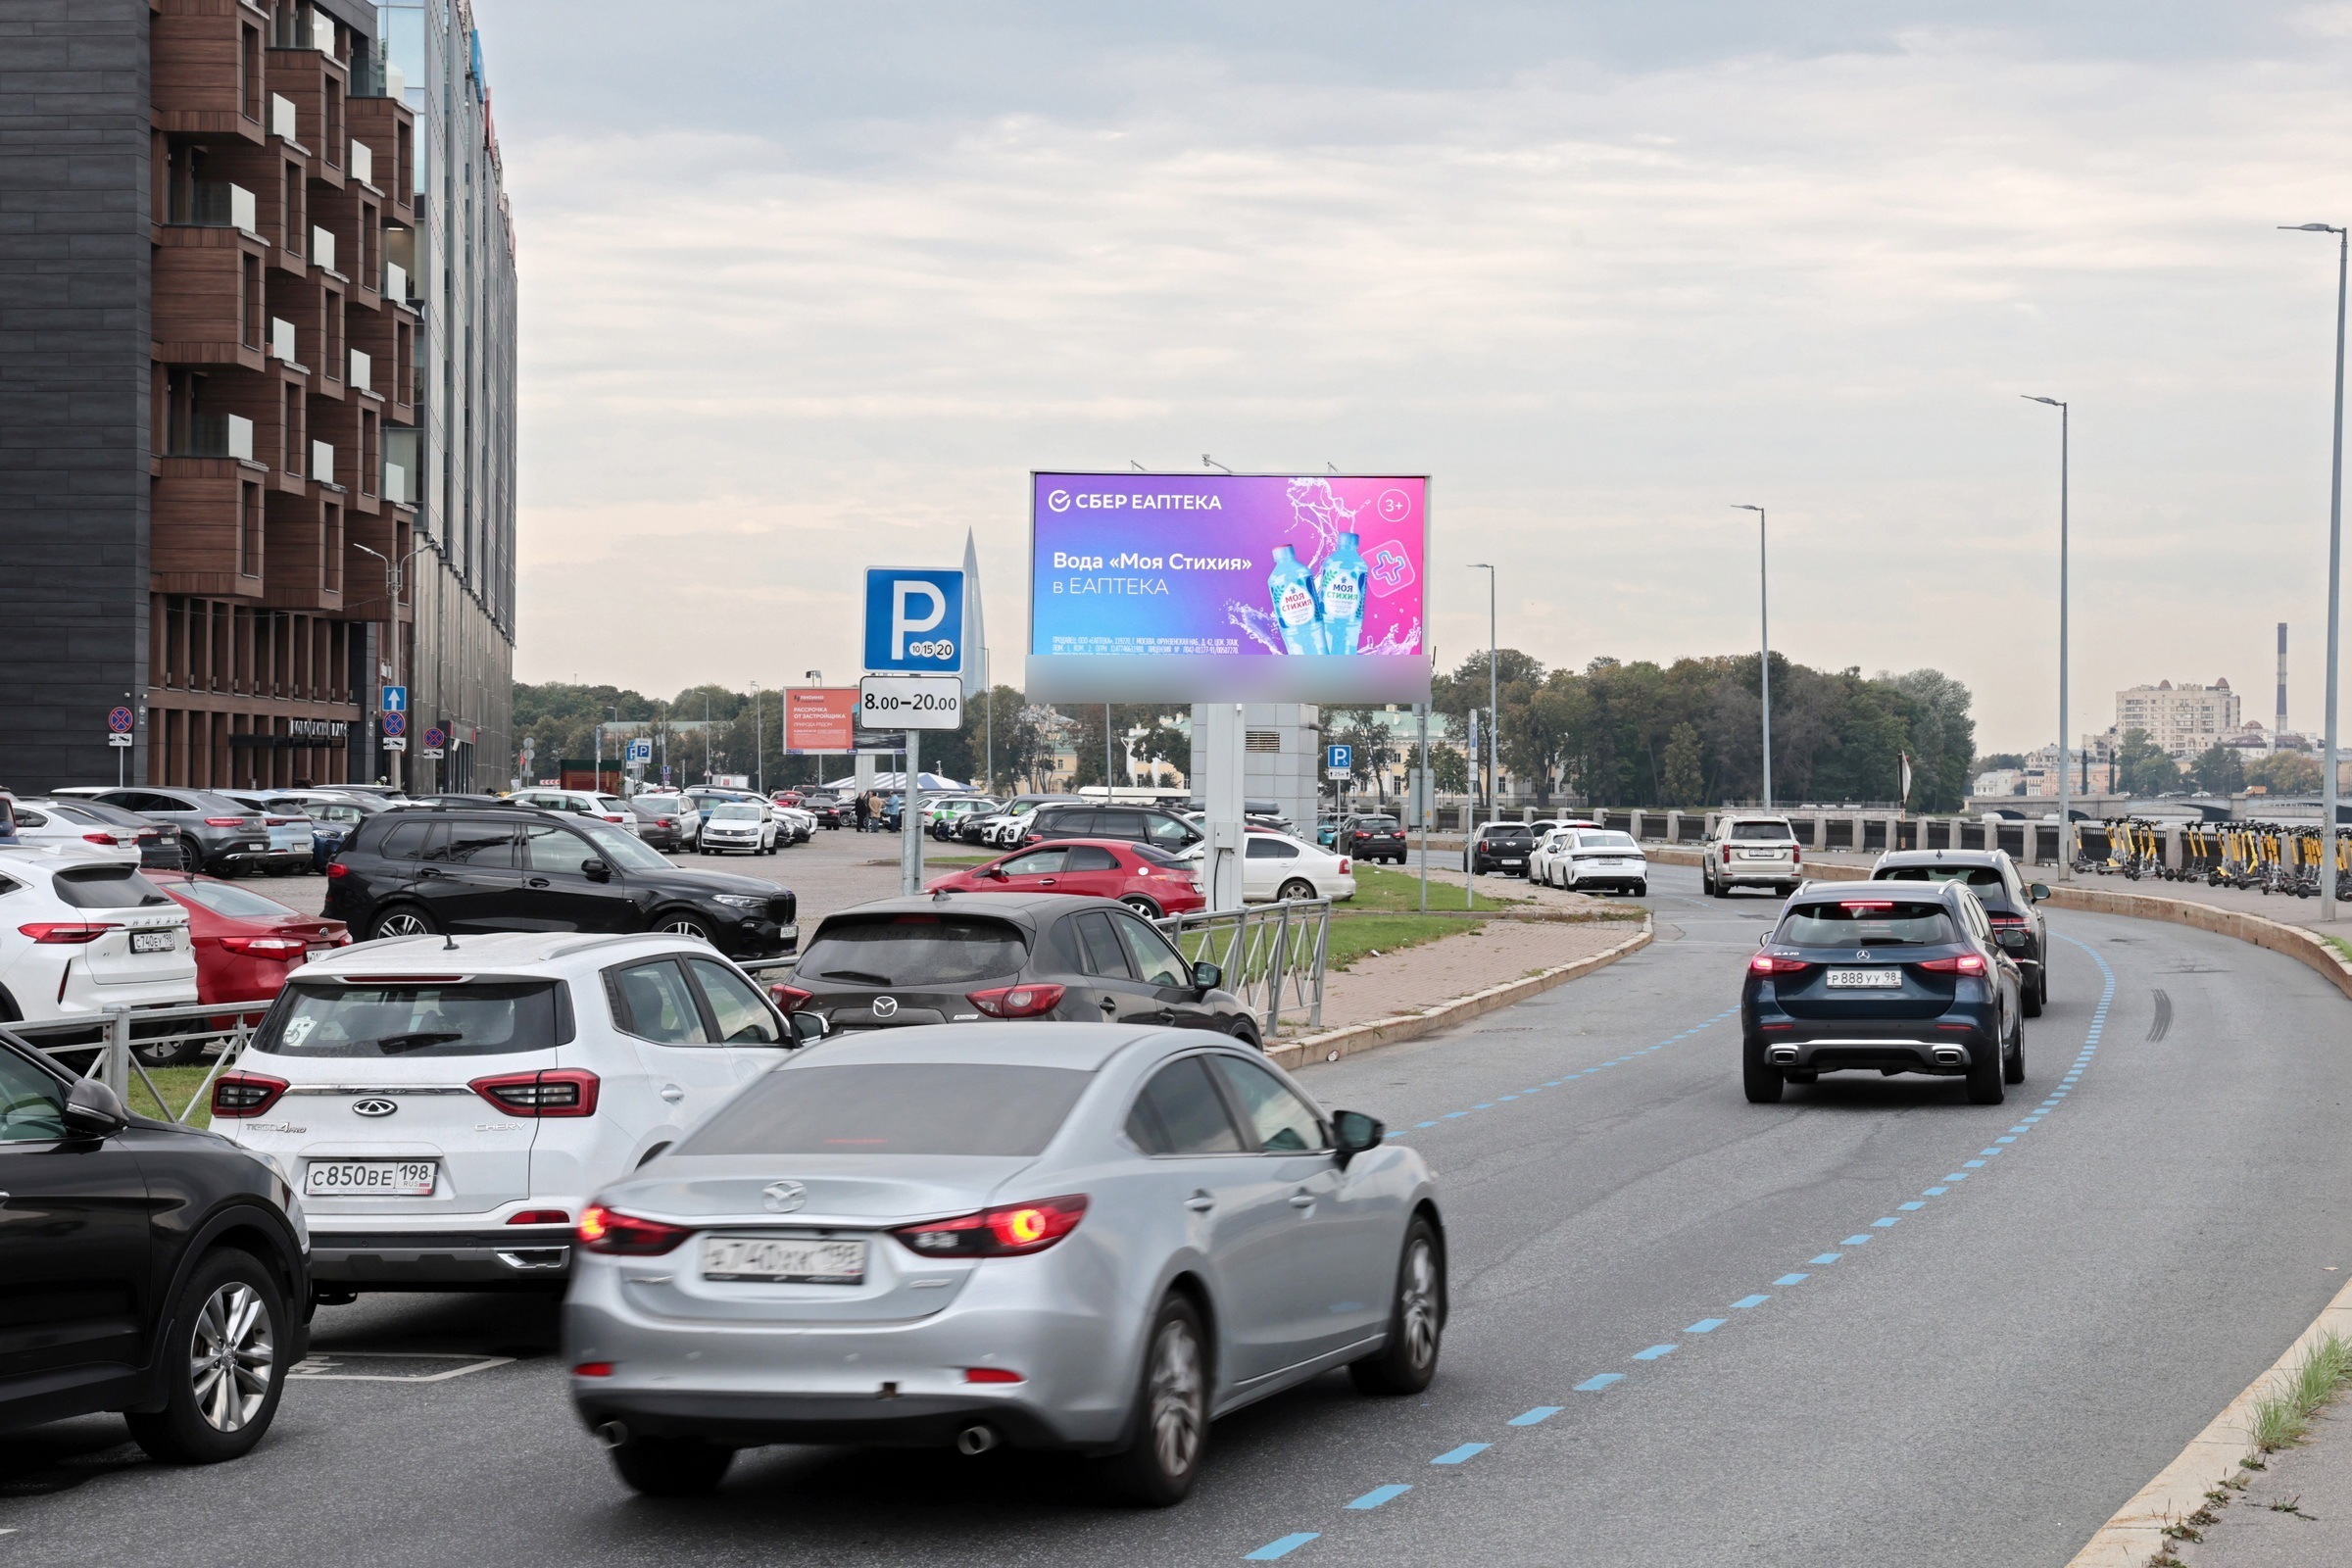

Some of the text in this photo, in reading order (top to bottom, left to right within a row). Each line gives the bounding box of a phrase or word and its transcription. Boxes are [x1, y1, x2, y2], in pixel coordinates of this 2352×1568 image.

[1076, 493, 1222, 510] СБЕР ЕАПТЕКА
[1385, 499, 1403, 512] 3+
[1054, 552, 1252, 570] Вода «Моя Стихия»
[1053, 578, 1169, 595] в ЕАПТЕКА
[1333, 584, 1353, 592] МОЯ
[1285, 592, 1305, 603] МОЯ
[1326, 591, 1358, 600] СТИХИЯ
[1282, 599, 1312, 612] СТИХИЯ
[891, 580, 946, 660] P
[923, 644, 933, 655] 15
[936, 644, 952, 656] 20
[640, 746, 647, 756] P
[1335, 748, 1347, 765] P
[1884, 972, 1896, 981] 98
[475, 1122, 525, 1131] CHERY
[313, 1165, 428, 1186] С850ВЕ 198
